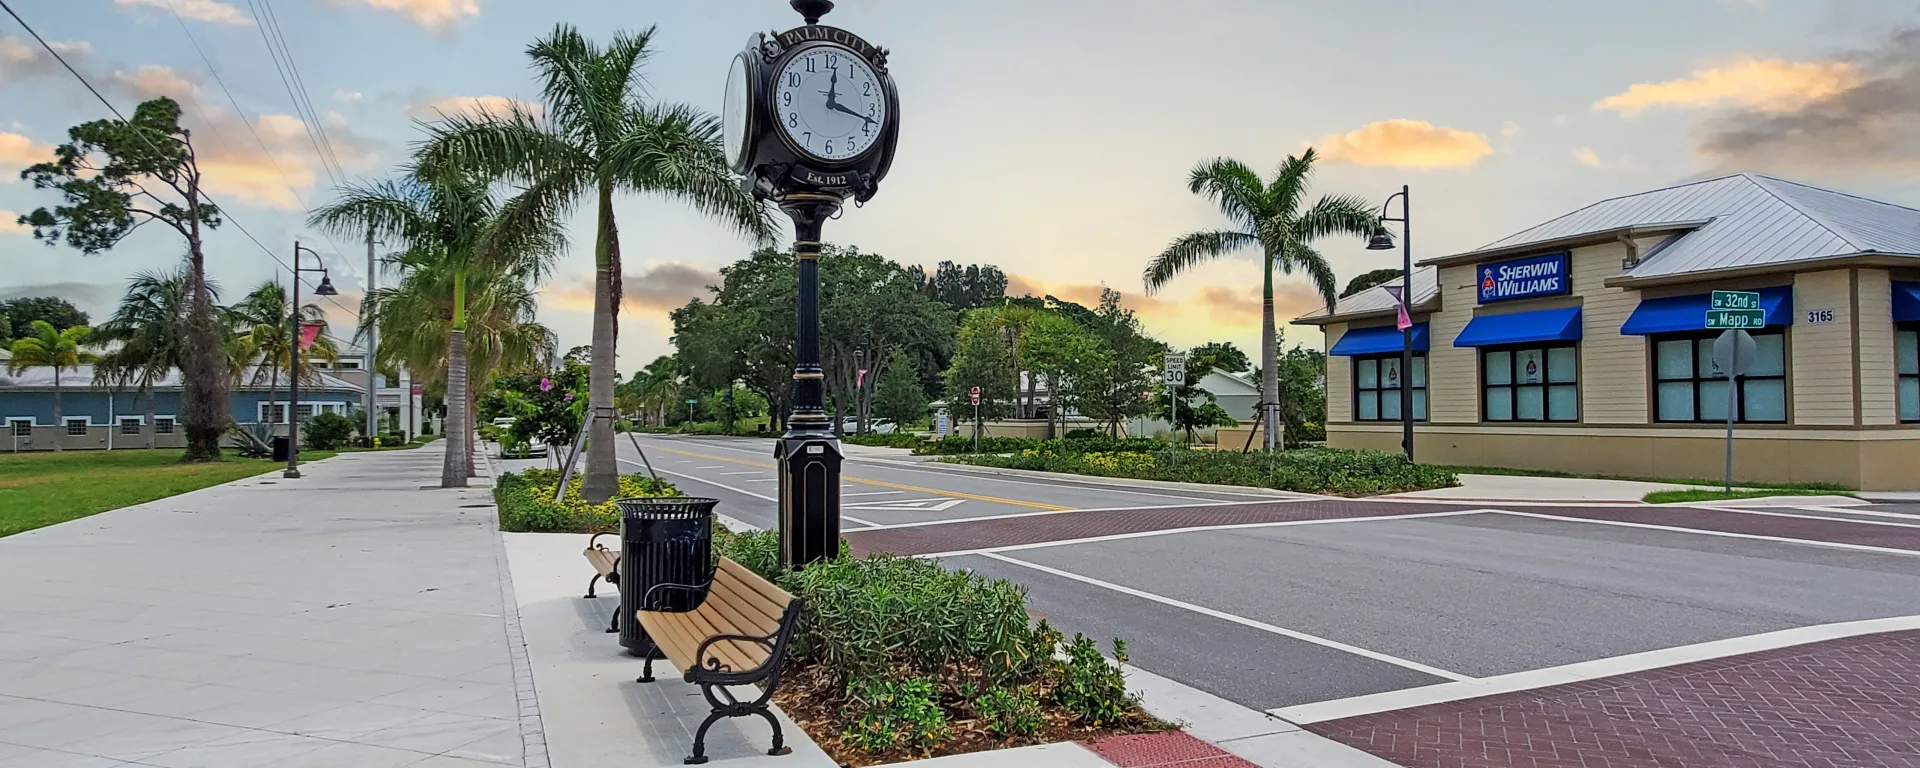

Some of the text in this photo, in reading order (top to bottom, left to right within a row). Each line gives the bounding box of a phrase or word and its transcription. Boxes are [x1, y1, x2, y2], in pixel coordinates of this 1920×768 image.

[785, 27, 871, 54] PALM CITY
[805, 58, 816, 73] 11
[824, 55, 838, 70] 12
[848, 64, 855, 79] 1
[788, 72, 801, 87] 10
[862, 82, 871, 97] 2
[783, 91, 792, 107] 9
[868, 103, 876, 117] 3
[789, 112, 798, 128] 8
[861, 120, 870, 137] 4
[802, 132, 811, 147] 7
[825, 139, 833, 155] 6
[847, 136, 856, 152] 5
[807, 172, 847, 185] Est. 1912
[1498, 261, 1559, 281] SHERWIN
[1497, 277, 1560, 297] WILLIAMS
[1714, 299, 1722, 307] SW
[1725, 293, 1749, 308] 32nd
[1707, 312, 1762, 328] SW Mapp RD
[1808, 310, 1833, 323] 3165
[1166, 370, 1183, 382] 30
